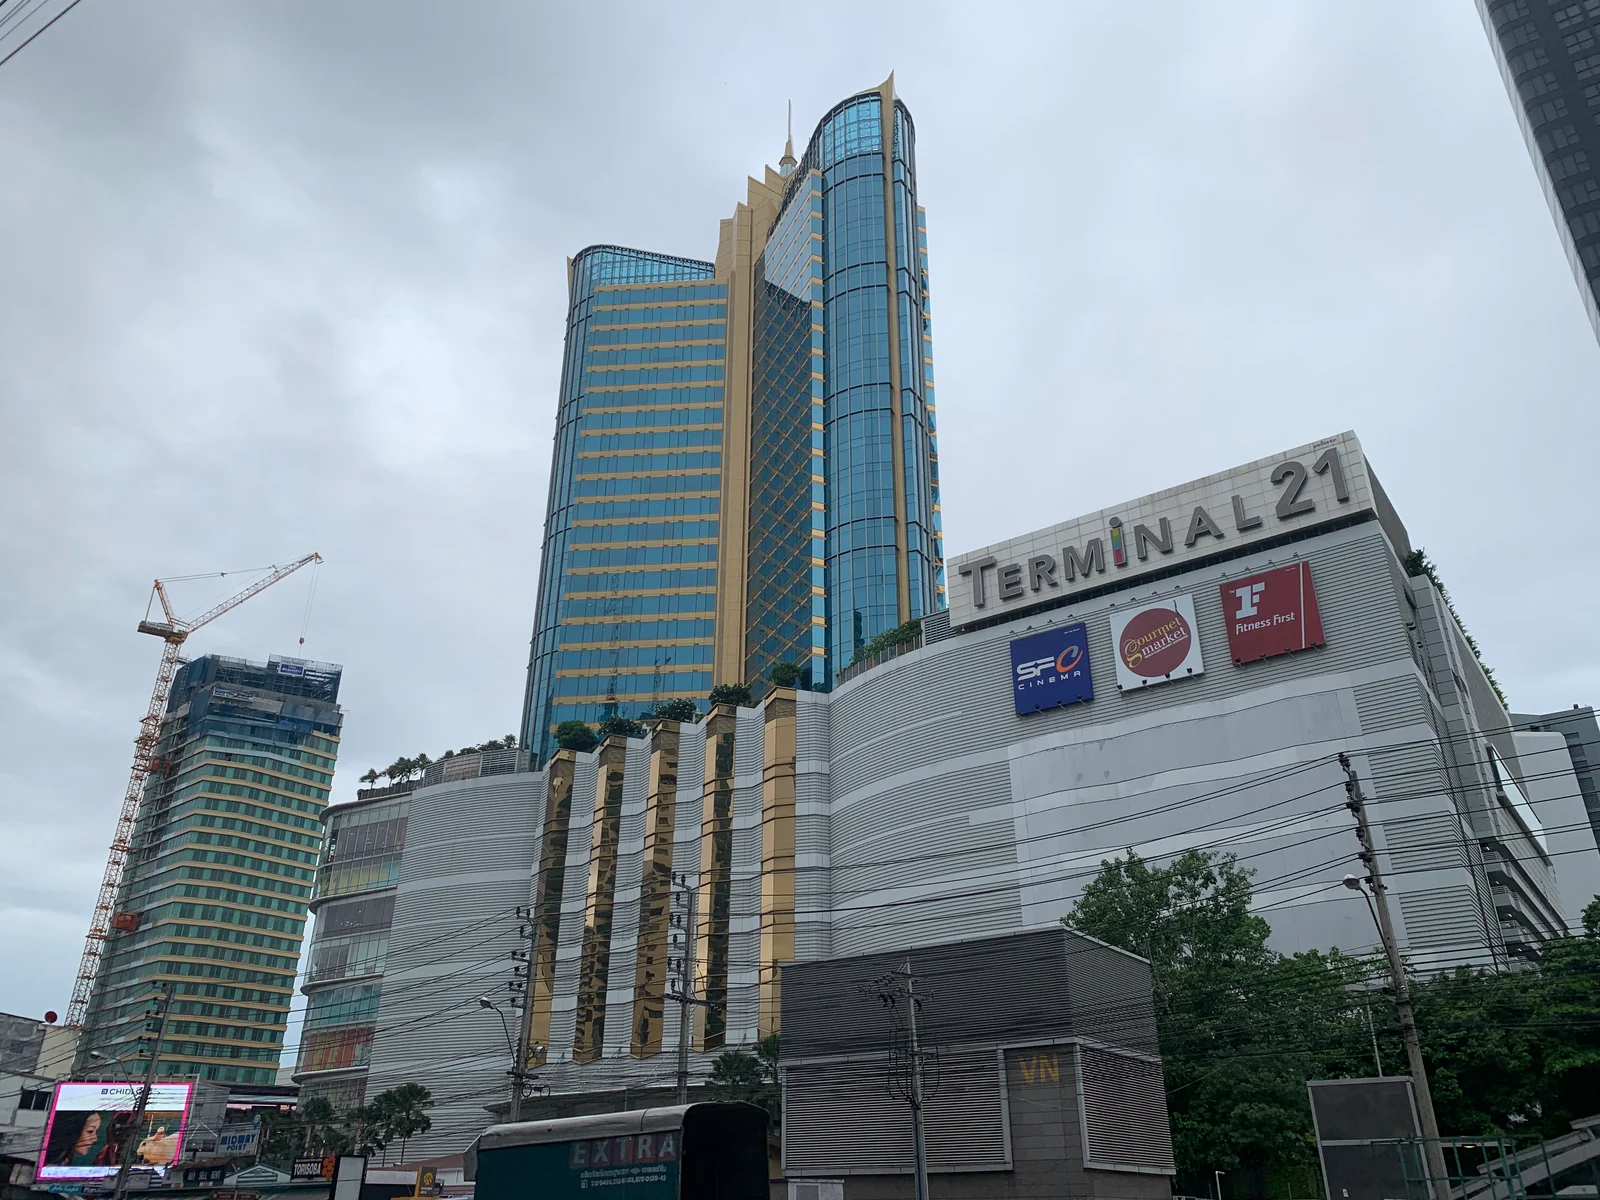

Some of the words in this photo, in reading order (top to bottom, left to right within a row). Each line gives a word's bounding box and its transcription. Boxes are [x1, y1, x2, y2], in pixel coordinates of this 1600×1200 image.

[1236, 619, 1271, 635] Fitness
[1273, 612, 1296, 626] First
[1123, 616, 1182, 668] Gourmet
[1141, 626, 1187, 656] market
[1018, 670, 1081, 690] CINEMA
[219, 1133, 256, 1144] MIDWAY
[573, 1133, 677, 1164] EXTRA
